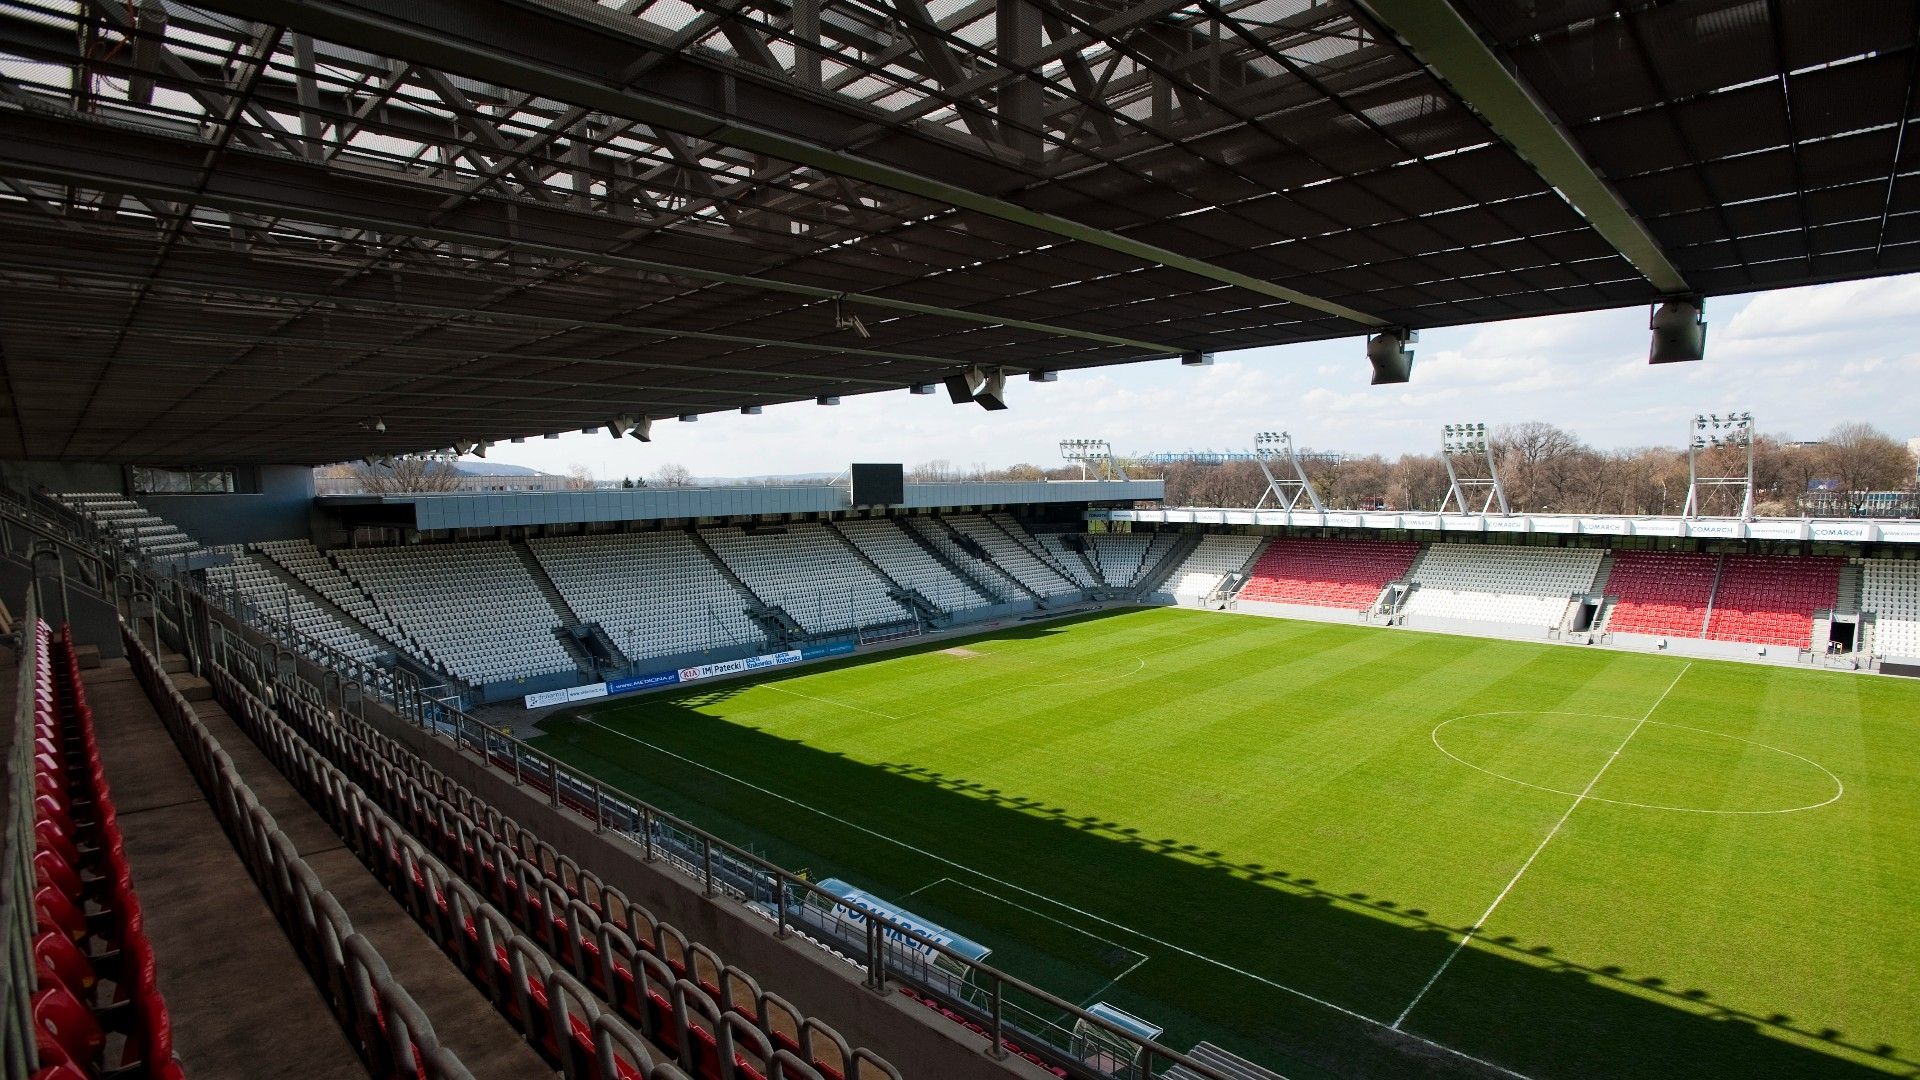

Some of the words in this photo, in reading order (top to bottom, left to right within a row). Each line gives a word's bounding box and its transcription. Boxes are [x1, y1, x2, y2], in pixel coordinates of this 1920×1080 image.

[1584, 523, 1620, 531] COMARCH
[1691, 526, 1733, 534] COMARCH
[1814, 528, 1863, 537] COMARCH
[714, 661, 742, 673] Patecki
[683, 669, 698, 678] KIA
